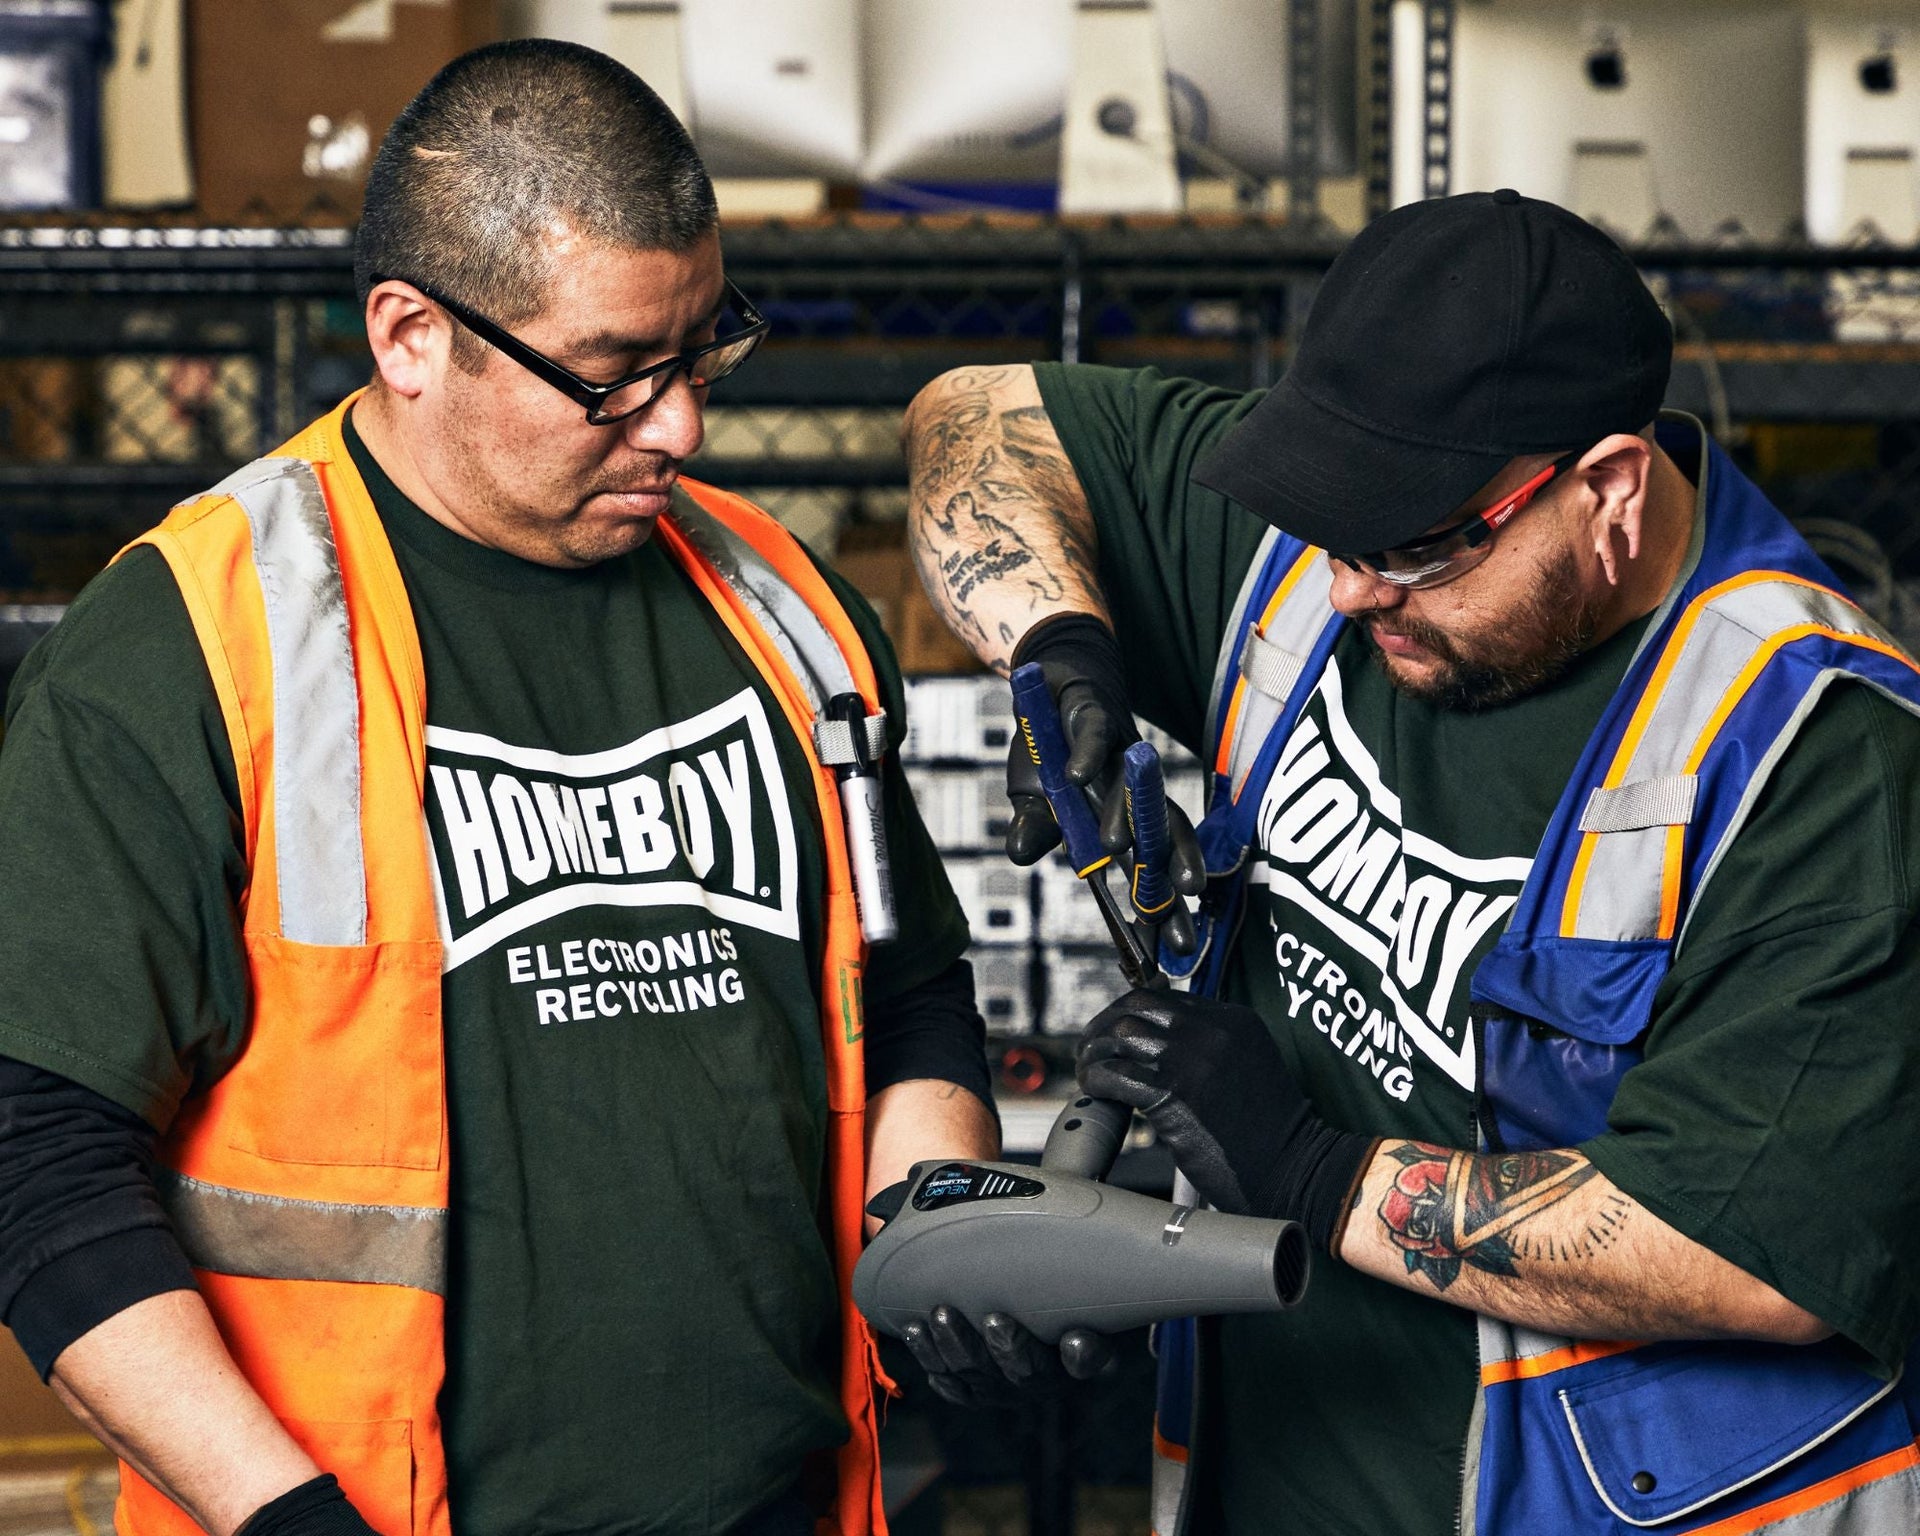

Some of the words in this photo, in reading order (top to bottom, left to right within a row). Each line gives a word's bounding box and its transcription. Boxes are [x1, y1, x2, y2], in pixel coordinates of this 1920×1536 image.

[429, 739, 756, 919] HOMEBOY
[507, 928, 738, 984] ELECTRONICS
[536, 967, 746, 1025] RECYCLING
[1280, 973, 1414, 1103] YCLING
[925, 1184, 970, 1197] NEURO
